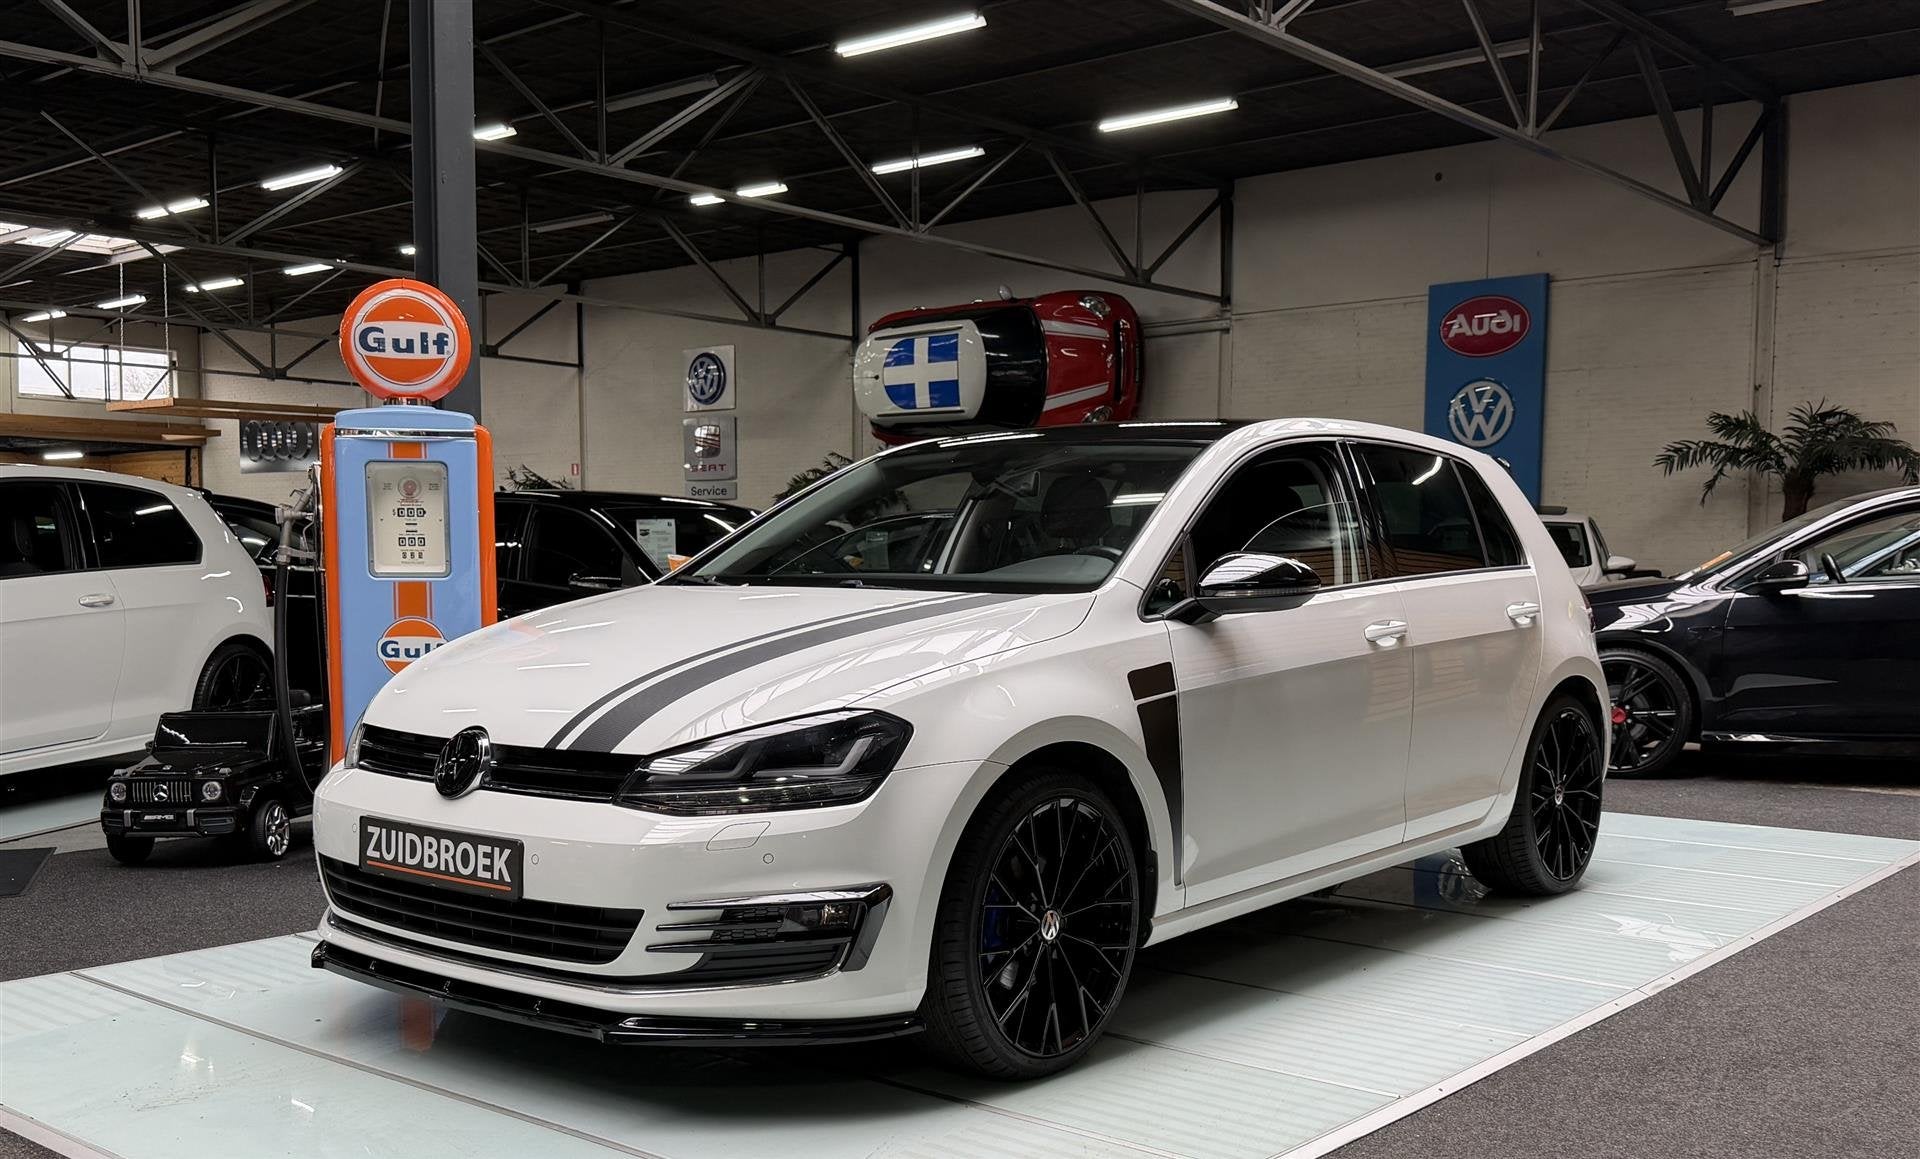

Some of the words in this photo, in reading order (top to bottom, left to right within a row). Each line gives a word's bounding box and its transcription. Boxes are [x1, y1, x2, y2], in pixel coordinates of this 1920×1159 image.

[359, 326, 450, 355] Gulf
[690, 463, 727, 473] SEAT
[690, 485, 728, 497] Service
[380, 640, 444, 659] Gul
[366, 825, 512, 883] ZUIDBROEK
